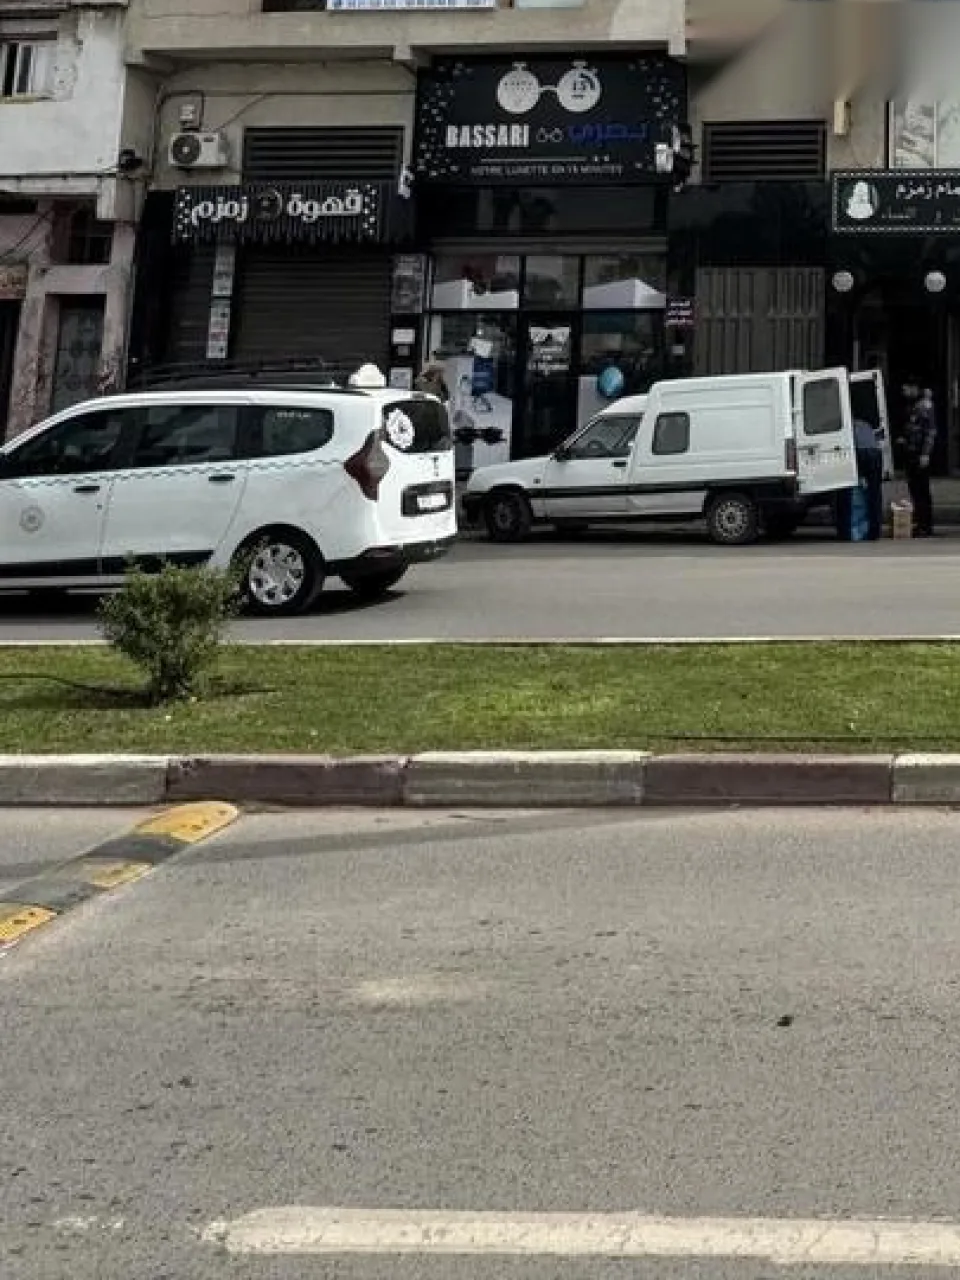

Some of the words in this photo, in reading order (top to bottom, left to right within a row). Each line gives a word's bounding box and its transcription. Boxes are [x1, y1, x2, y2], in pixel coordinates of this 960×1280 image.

[445, 124, 530, 148] BASSARI
[895, 180, 933, 200] زمزم
[191, 195, 249, 226] زمزم
[286, 189, 363, 224] قهوة
